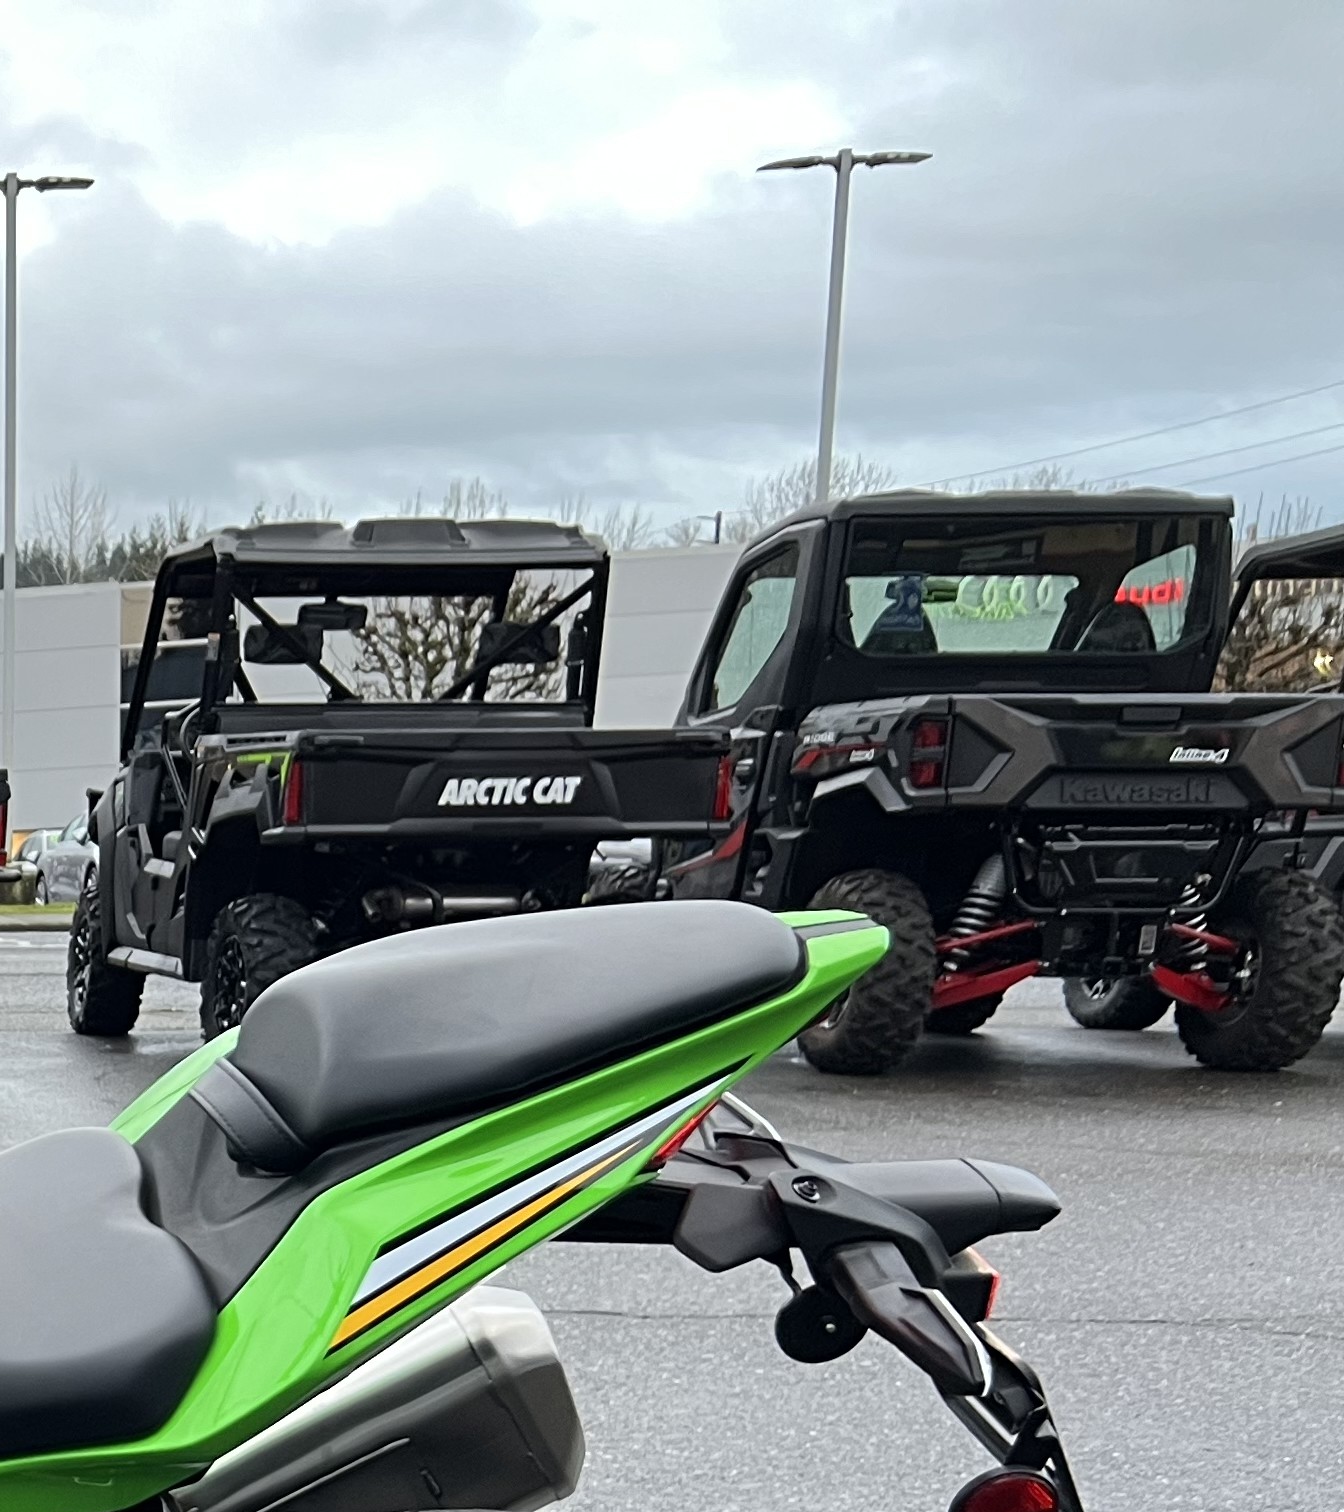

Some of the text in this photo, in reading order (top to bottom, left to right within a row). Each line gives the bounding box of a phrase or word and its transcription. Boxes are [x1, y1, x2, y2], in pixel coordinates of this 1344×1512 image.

[437, 776, 582, 806] ARCTIC CAT
[1060, 775, 1216, 803] Kawasaki
